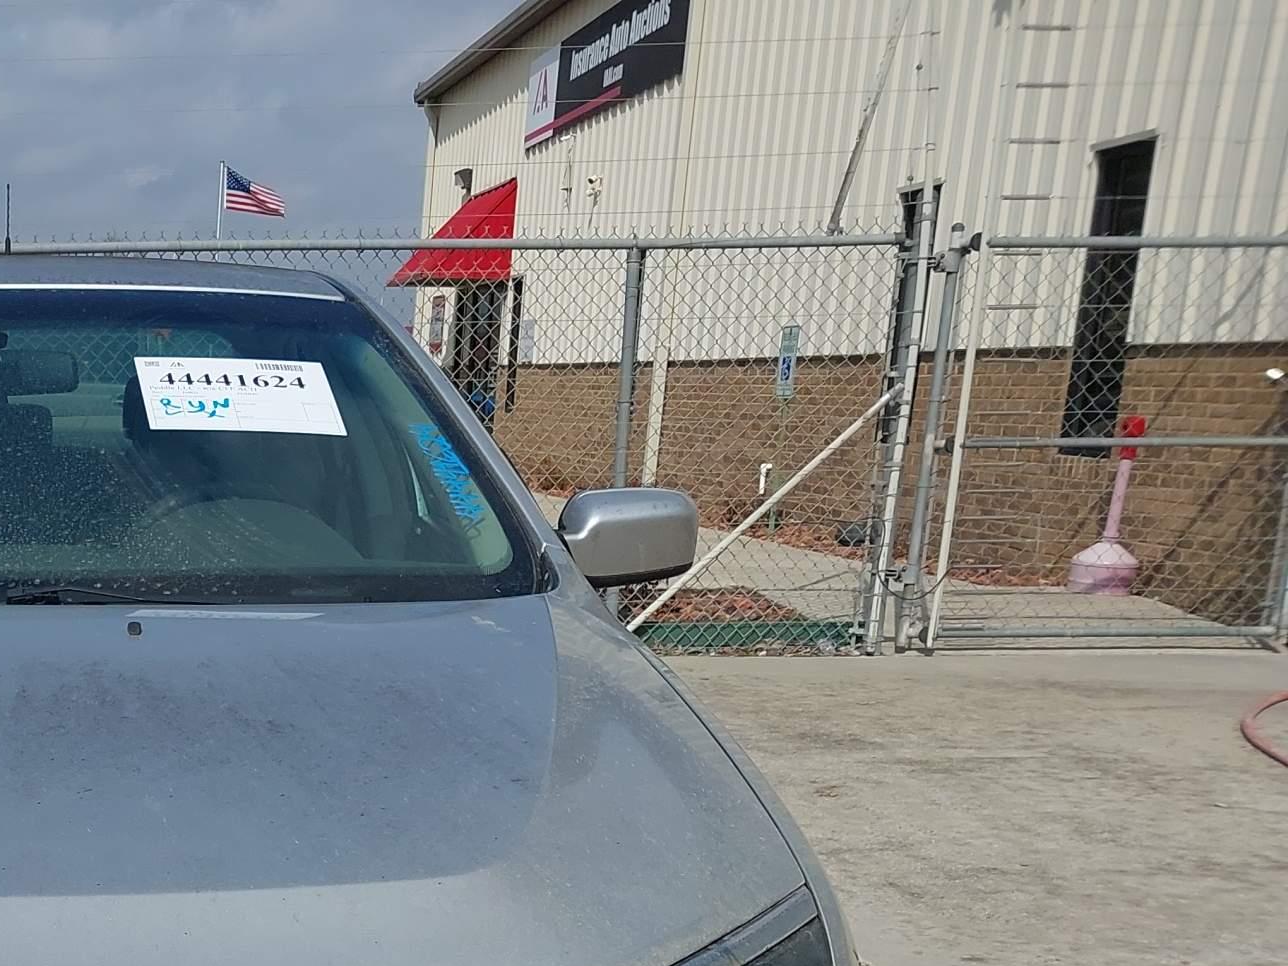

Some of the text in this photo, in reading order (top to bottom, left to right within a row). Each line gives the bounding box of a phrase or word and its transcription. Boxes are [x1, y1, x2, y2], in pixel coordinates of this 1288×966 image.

[569, 0, 671, 81] Insurance Auto Auctions
[159, 373, 306, 389] 44441624
